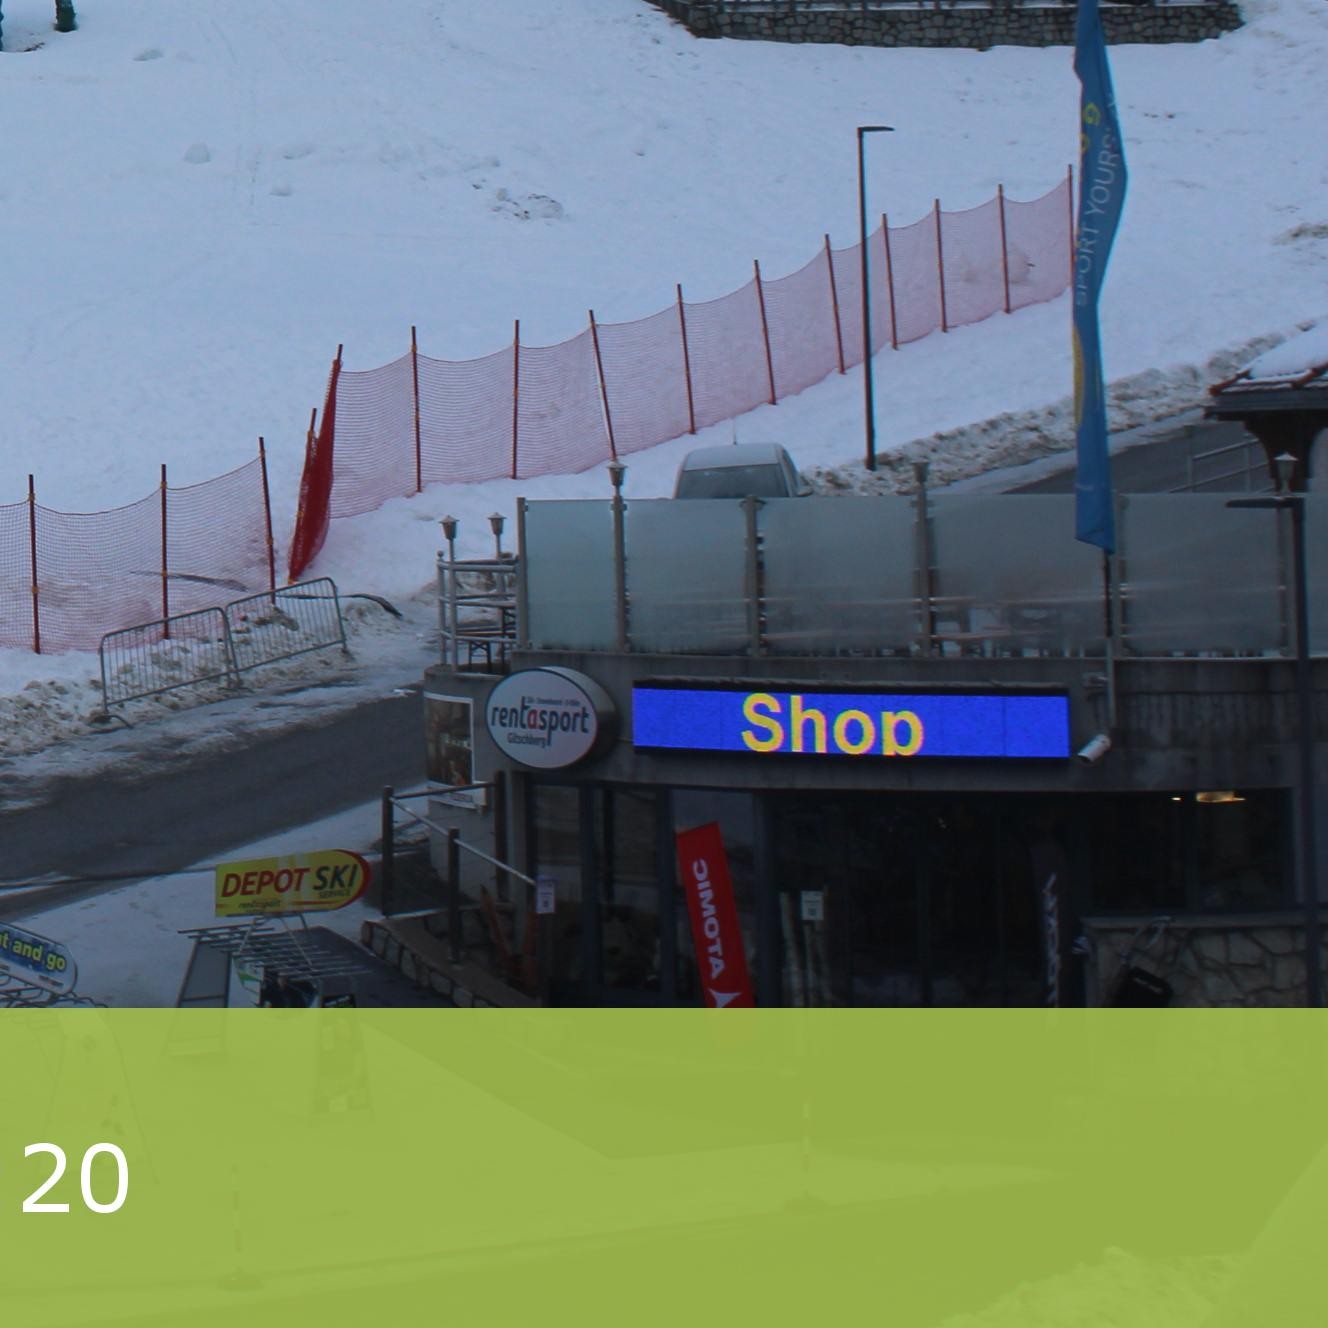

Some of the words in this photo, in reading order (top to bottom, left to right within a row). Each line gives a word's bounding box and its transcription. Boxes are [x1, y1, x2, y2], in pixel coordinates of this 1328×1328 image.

[491, 696, 589, 746] rentasport
[741, 692, 923, 756] Shop
[221, 867, 311, 898] DEPOT
[313, 863, 358, 891] SKI
[692, 858, 726, 980] ATOMIC
[12, 939, 42, 962] and
[46, 952, 66, 971] go
